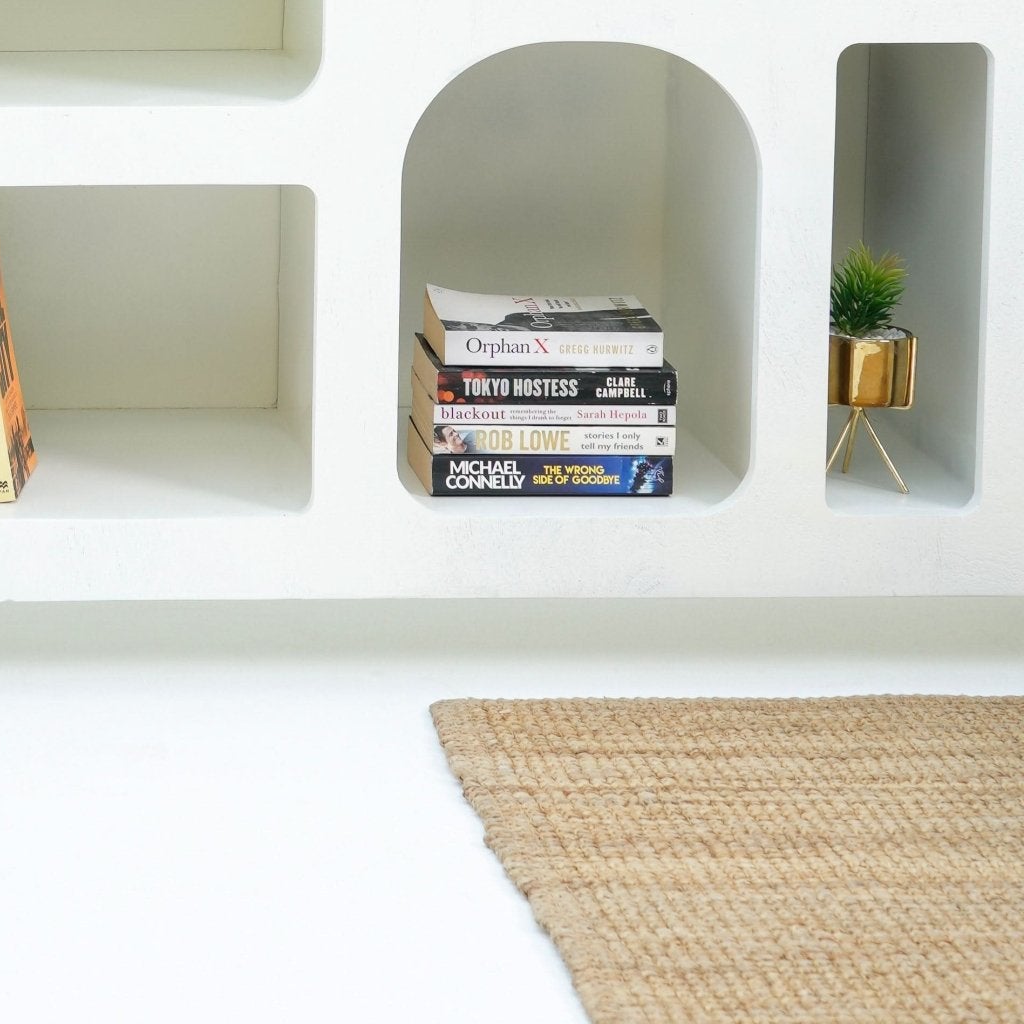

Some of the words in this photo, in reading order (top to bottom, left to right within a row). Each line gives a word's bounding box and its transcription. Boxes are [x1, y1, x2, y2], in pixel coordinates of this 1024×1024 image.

[466, 337, 530, 358] Orphan
[534, 338, 550, 353] X
[559, 344, 589, 355] GREGG
[593, 344, 634, 355] HURWITZ
[463, 378, 510, 396] TOKYO
[513, 378, 579, 397] HOSTESS
[606, 377, 636, 387] CLARE
[596, 388, 646, 398] CAMPBELL
[440, 407, 506, 420] blackout
[577, 409, 606, 419] Sarah
[610, 410, 647, 422] Hepola
[476, 430, 513, 451] ROB
[519, 430, 570, 451] LOWE
[622, 432, 641, 441] only
[581, 442, 595, 450] tell
[614, 442, 644, 450] friends
[449, 460, 521, 475] MICHAEL
[543, 465, 562, 475] THE
[564, 465, 605, 475] WRONG
[445, 475, 526, 489] CONNELLY
[532, 475, 554, 485] SIDE
[555, 475, 569, 485] OF
[571, 475, 621, 485] GOODBYE
